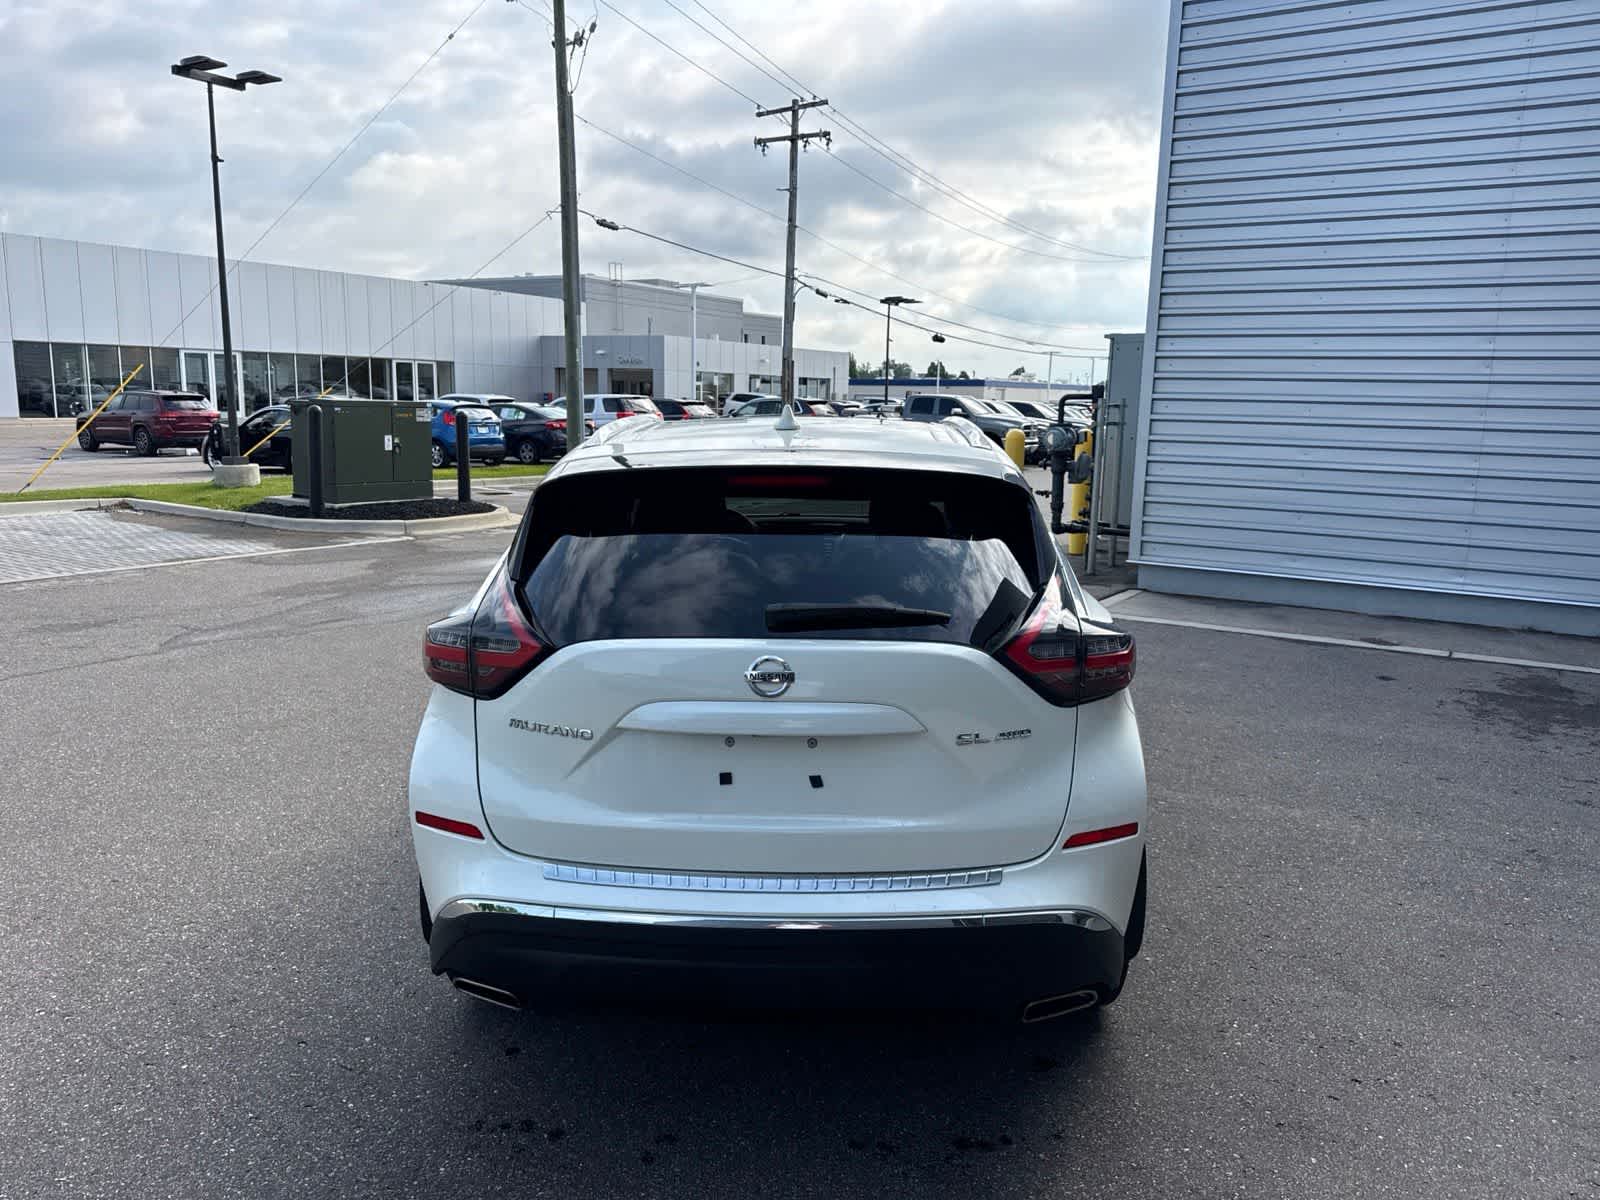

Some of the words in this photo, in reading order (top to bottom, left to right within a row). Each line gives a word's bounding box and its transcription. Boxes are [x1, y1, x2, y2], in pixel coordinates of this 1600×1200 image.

[748, 671, 792, 681] NISSAN
[509, 718, 594, 741] MURANO
[956, 732, 991, 746] SL
